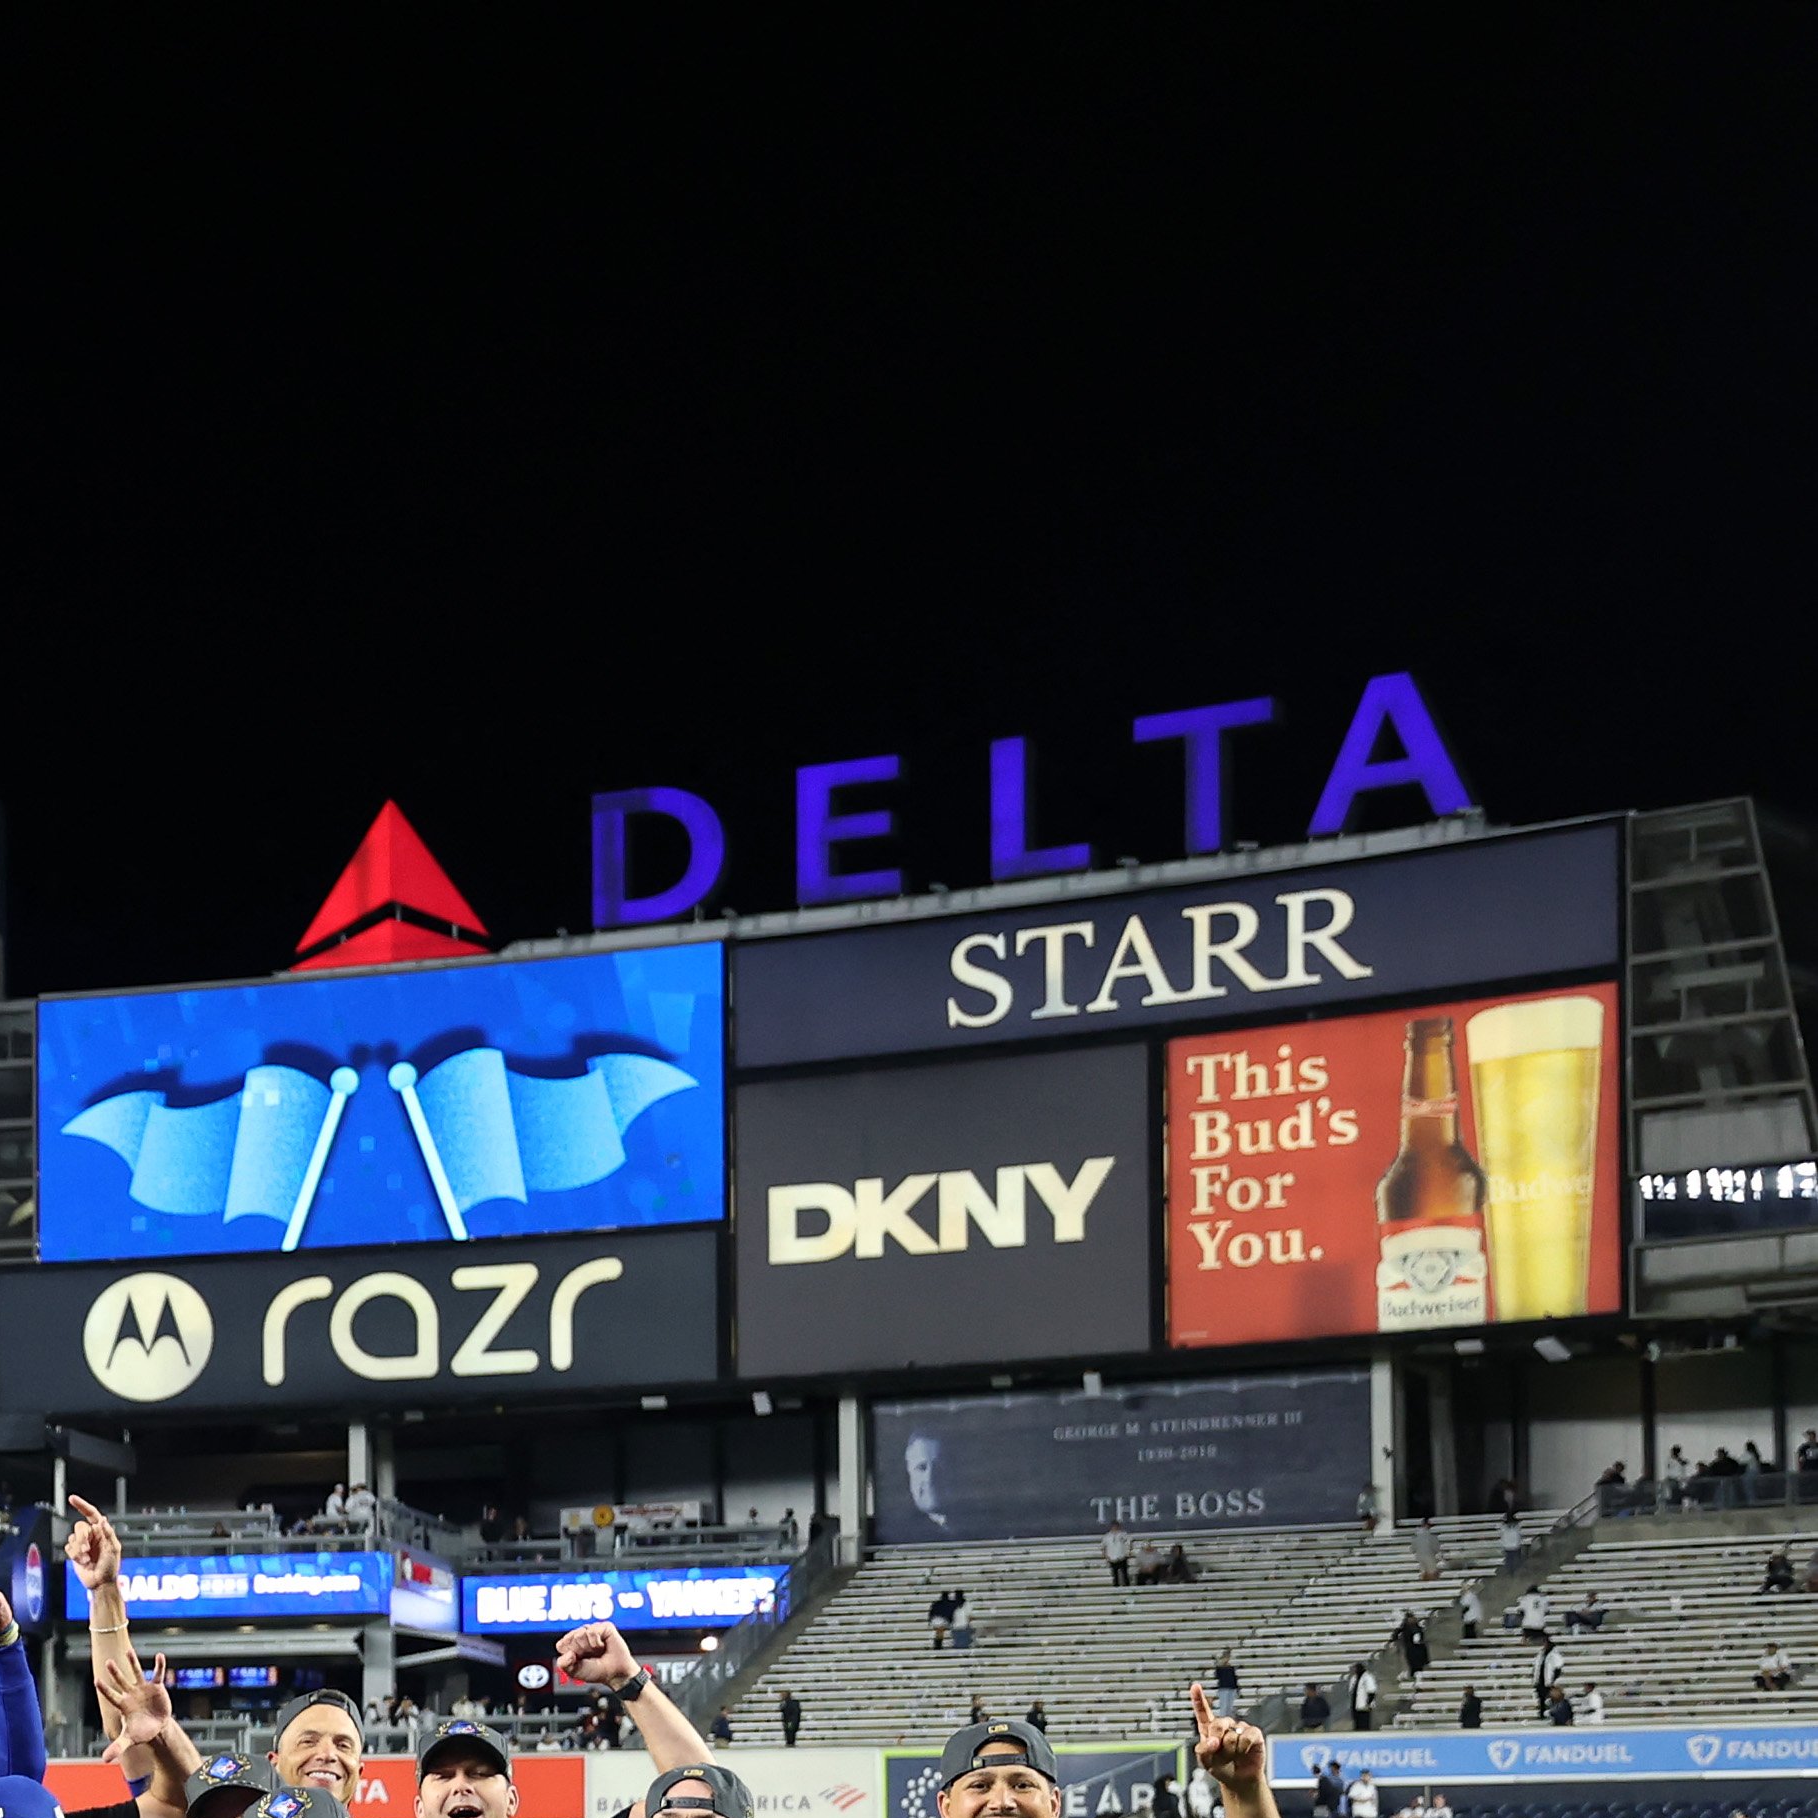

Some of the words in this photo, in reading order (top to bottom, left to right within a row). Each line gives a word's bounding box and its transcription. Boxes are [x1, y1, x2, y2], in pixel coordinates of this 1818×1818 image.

[592, 671, 1471, 929] DELTA
[948, 888, 1373, 1028] STARR
[1186, 1044, 1330, 1104] This
[1189, 1096, 1360, 1160] Bud's
[768, 1157, 1115, 1266] DKNY
[1190, 1163, 1295, 1215] For
[1187, 1219, 1325, 1271] You.
[263, 1257, 624, 1387] razr
[1090, 1494, 1161, 1523] THE
[1177, 1488, 1266, 1518] BOSS
[1525, 1743, 1633, 1763] FANDUEL
[1727, 1739, 1818, 1760] FANDUE
[597, 1797, 645, 1813] BAN
